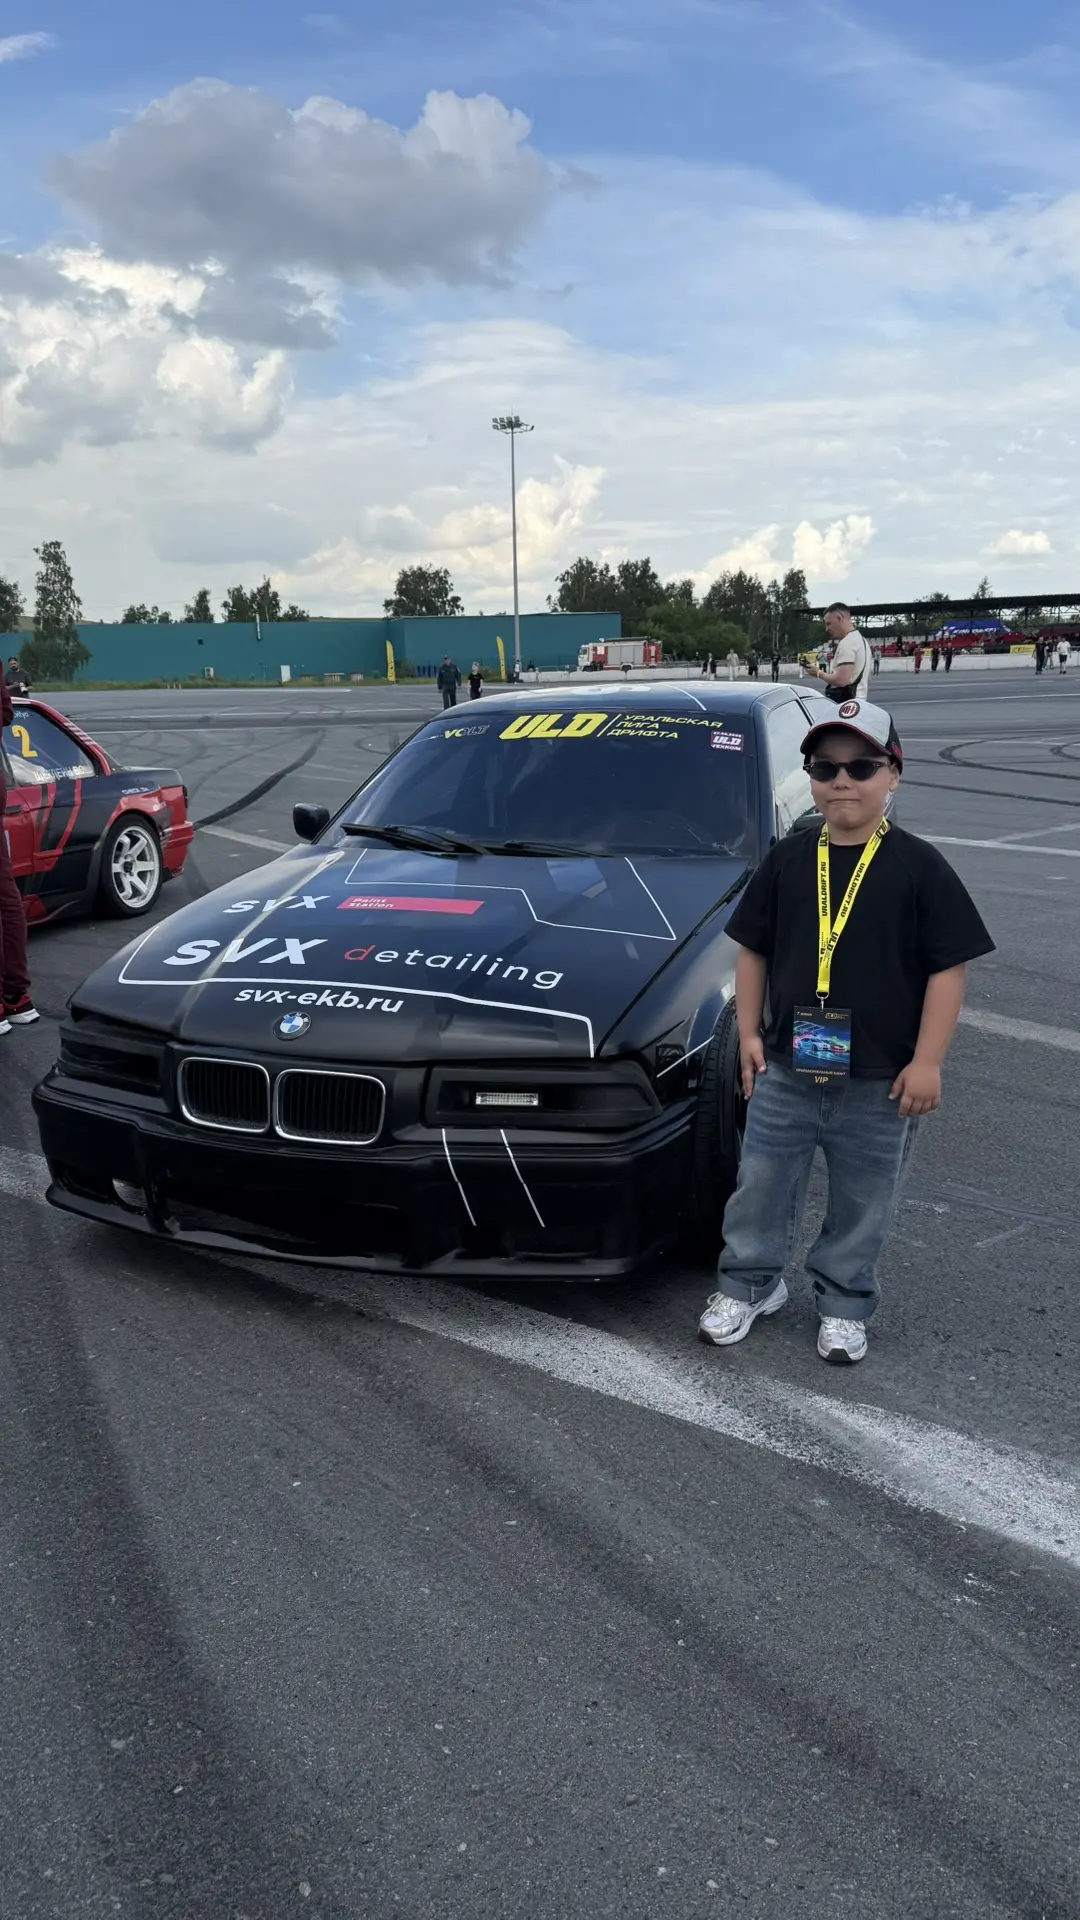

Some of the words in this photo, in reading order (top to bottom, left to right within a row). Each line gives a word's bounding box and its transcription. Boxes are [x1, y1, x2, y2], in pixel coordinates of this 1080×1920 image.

[499, 713, 608, 740] ULD
[614, 721, 660, 730] ЛИГА
[624, 714, 724, 729] УРАЛЬСКАЯ
[11, 725, 38, 758] 2
[444, 725, 490, 740] VOLT
[607, 728, 679, 739] ДРИФТА
[713, 735, 742, 746] ULD
[820, 861, 828, 917] URALDRIFT.RU
[840, 862, 866, 918] URALDRIFT.RU
[347, 901, 394, 909] Station
[826, 931, 839, 952] ULD
[343, 944, 565, 989] detailing
[234, 987, 404, 1013] svx-ekb.ru
[814, 1076, 829, 1084] VIP
